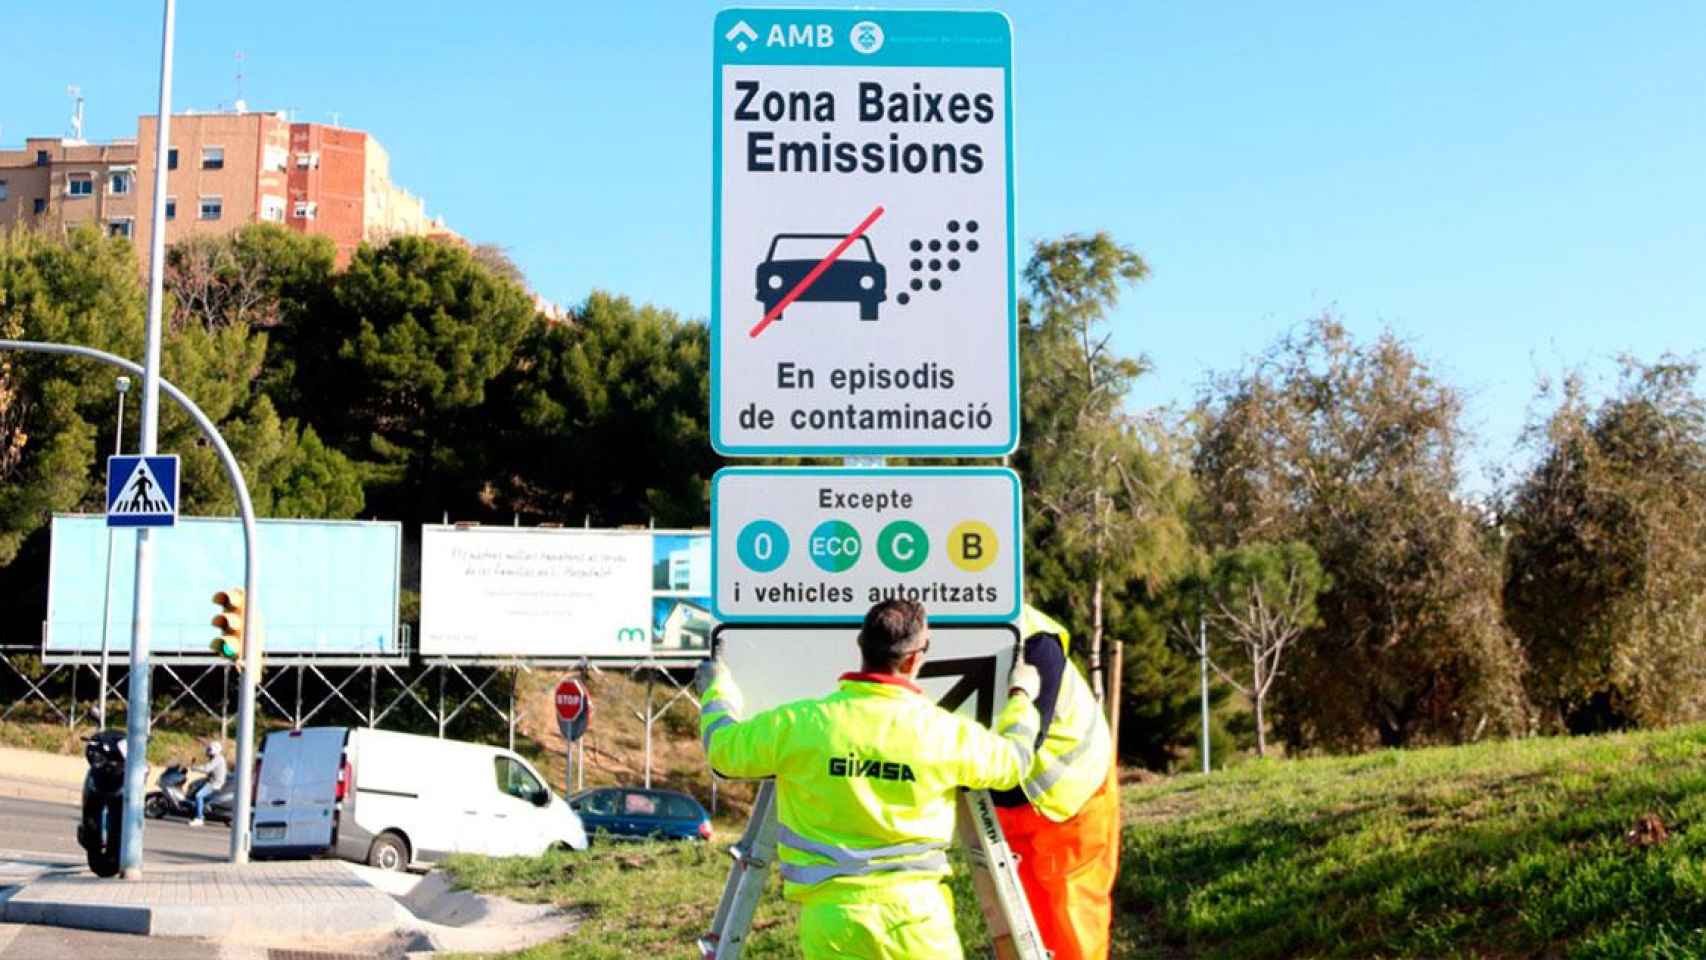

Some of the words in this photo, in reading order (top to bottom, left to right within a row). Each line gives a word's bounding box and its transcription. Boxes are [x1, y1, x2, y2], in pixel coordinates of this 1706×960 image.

[766, 24, 835, 48] AMB
[734, 80, 835, 122] Zona
[858, 81, 994, 124] Baixes
[746, 131, 985, 174] Emissions
[777, 362, 814, 389] En
[830, 363, 955, 395] episodis
[739, 403, 775, 430] de
[790, 402, 993, 431] contaminació
[819, 488, 913, 512] Excepte
[812, 538, 859, 556] ECO
[891, 533, 914, 561] C
[962, 533, 983, 560] B
[734, 583, 740, 602] i
[755, 583, 854, 603] vehicles
[868, 583, 997, 603] autoritzats
[557, 694, 580, 705] STOP
